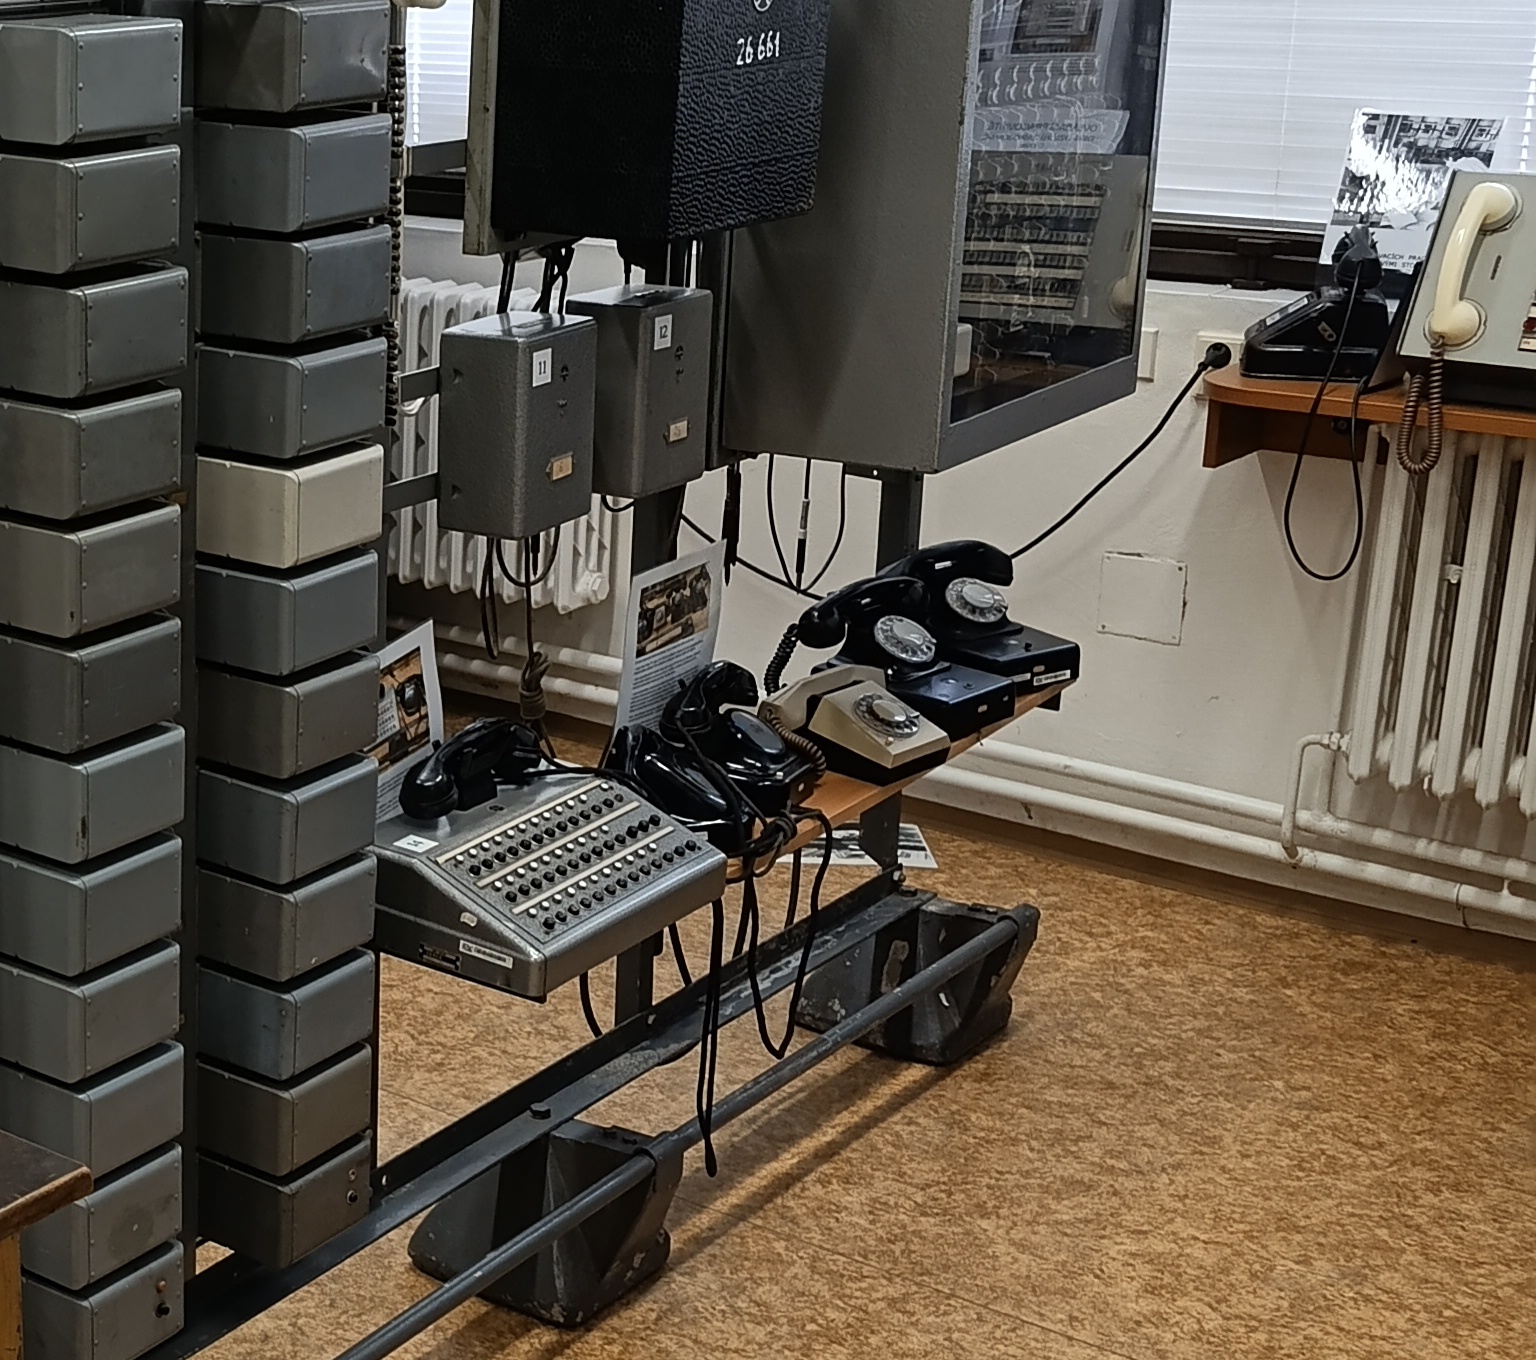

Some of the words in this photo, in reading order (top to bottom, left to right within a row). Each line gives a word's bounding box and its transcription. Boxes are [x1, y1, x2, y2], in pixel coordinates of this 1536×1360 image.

[736, 35, 754, 65] 26
[757, 30, 780, 60] 661
[658, 324, 669, 339] 12
[538, 359, 547, 376] 11
